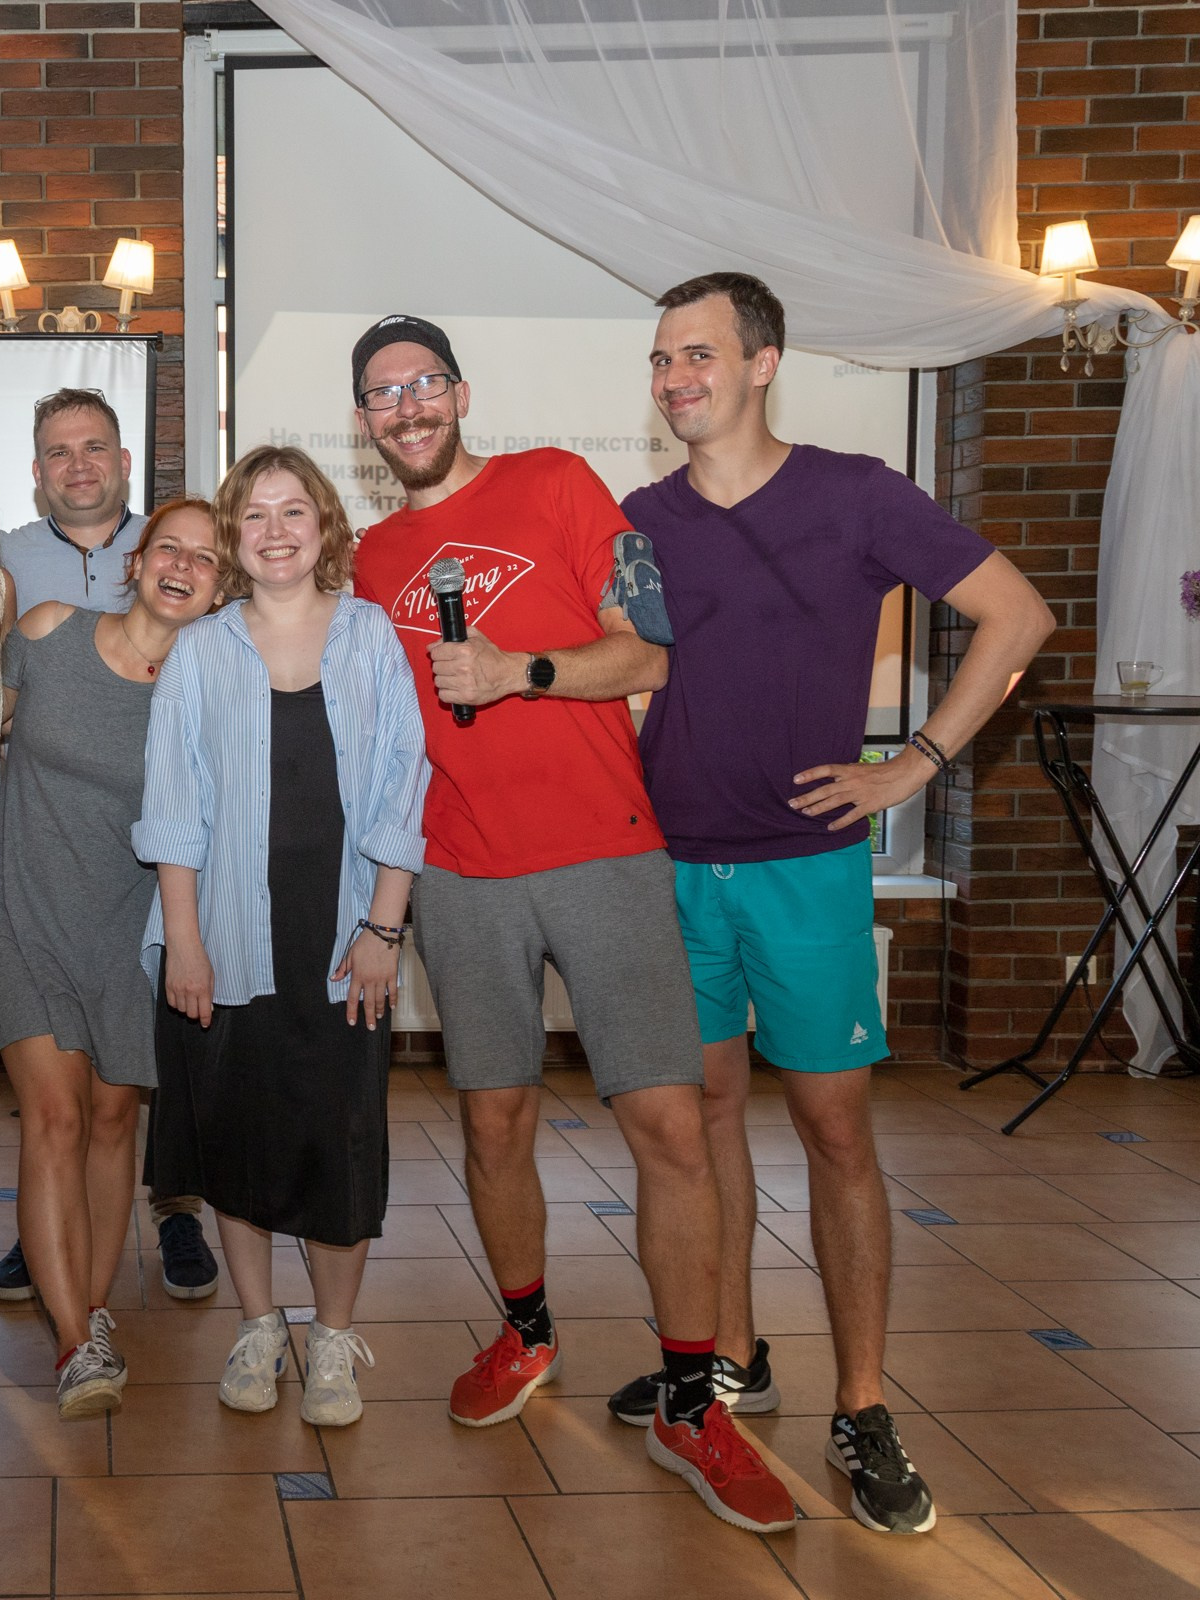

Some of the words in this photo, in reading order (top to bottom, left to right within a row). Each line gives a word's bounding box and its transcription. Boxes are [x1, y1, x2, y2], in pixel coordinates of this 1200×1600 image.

[270, 428, 301, 448] Не
[569, 437, 669, 452] текстов.
[506, 563, 519, 572] 32
